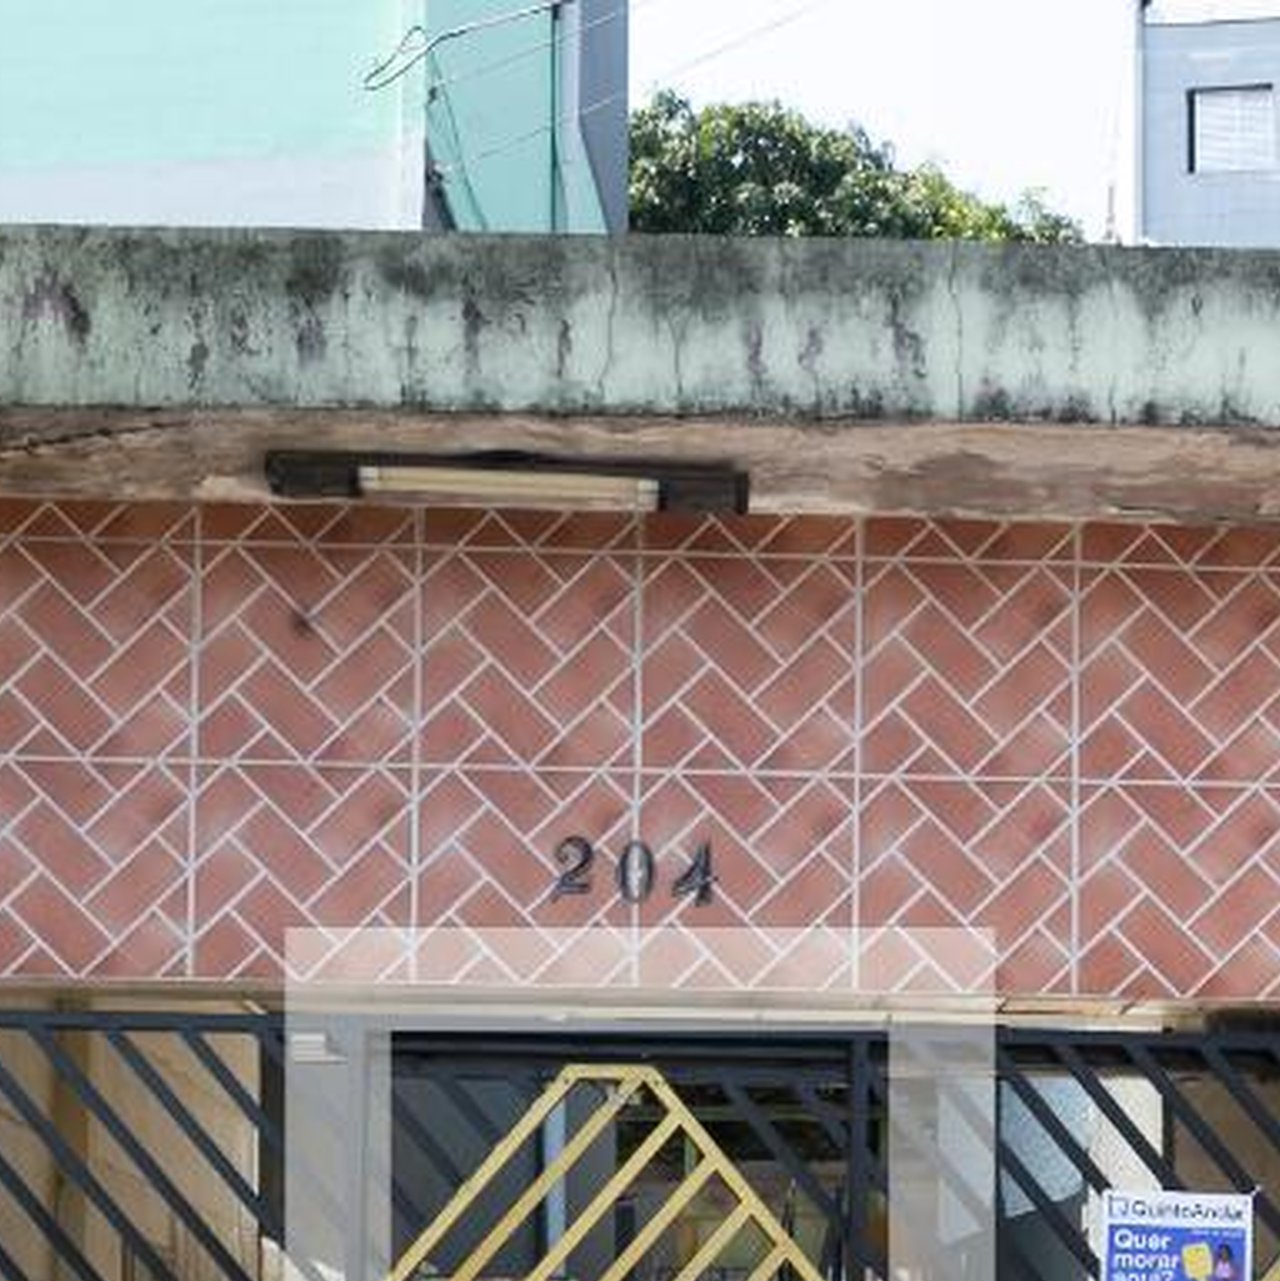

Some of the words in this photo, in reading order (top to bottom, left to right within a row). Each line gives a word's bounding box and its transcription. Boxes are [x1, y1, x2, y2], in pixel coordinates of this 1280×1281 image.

[553, 835, 718, 907] 204
[1113, 1228, 1171, 1249] Quer
[1112, 1252, 1180, 1269] morar
